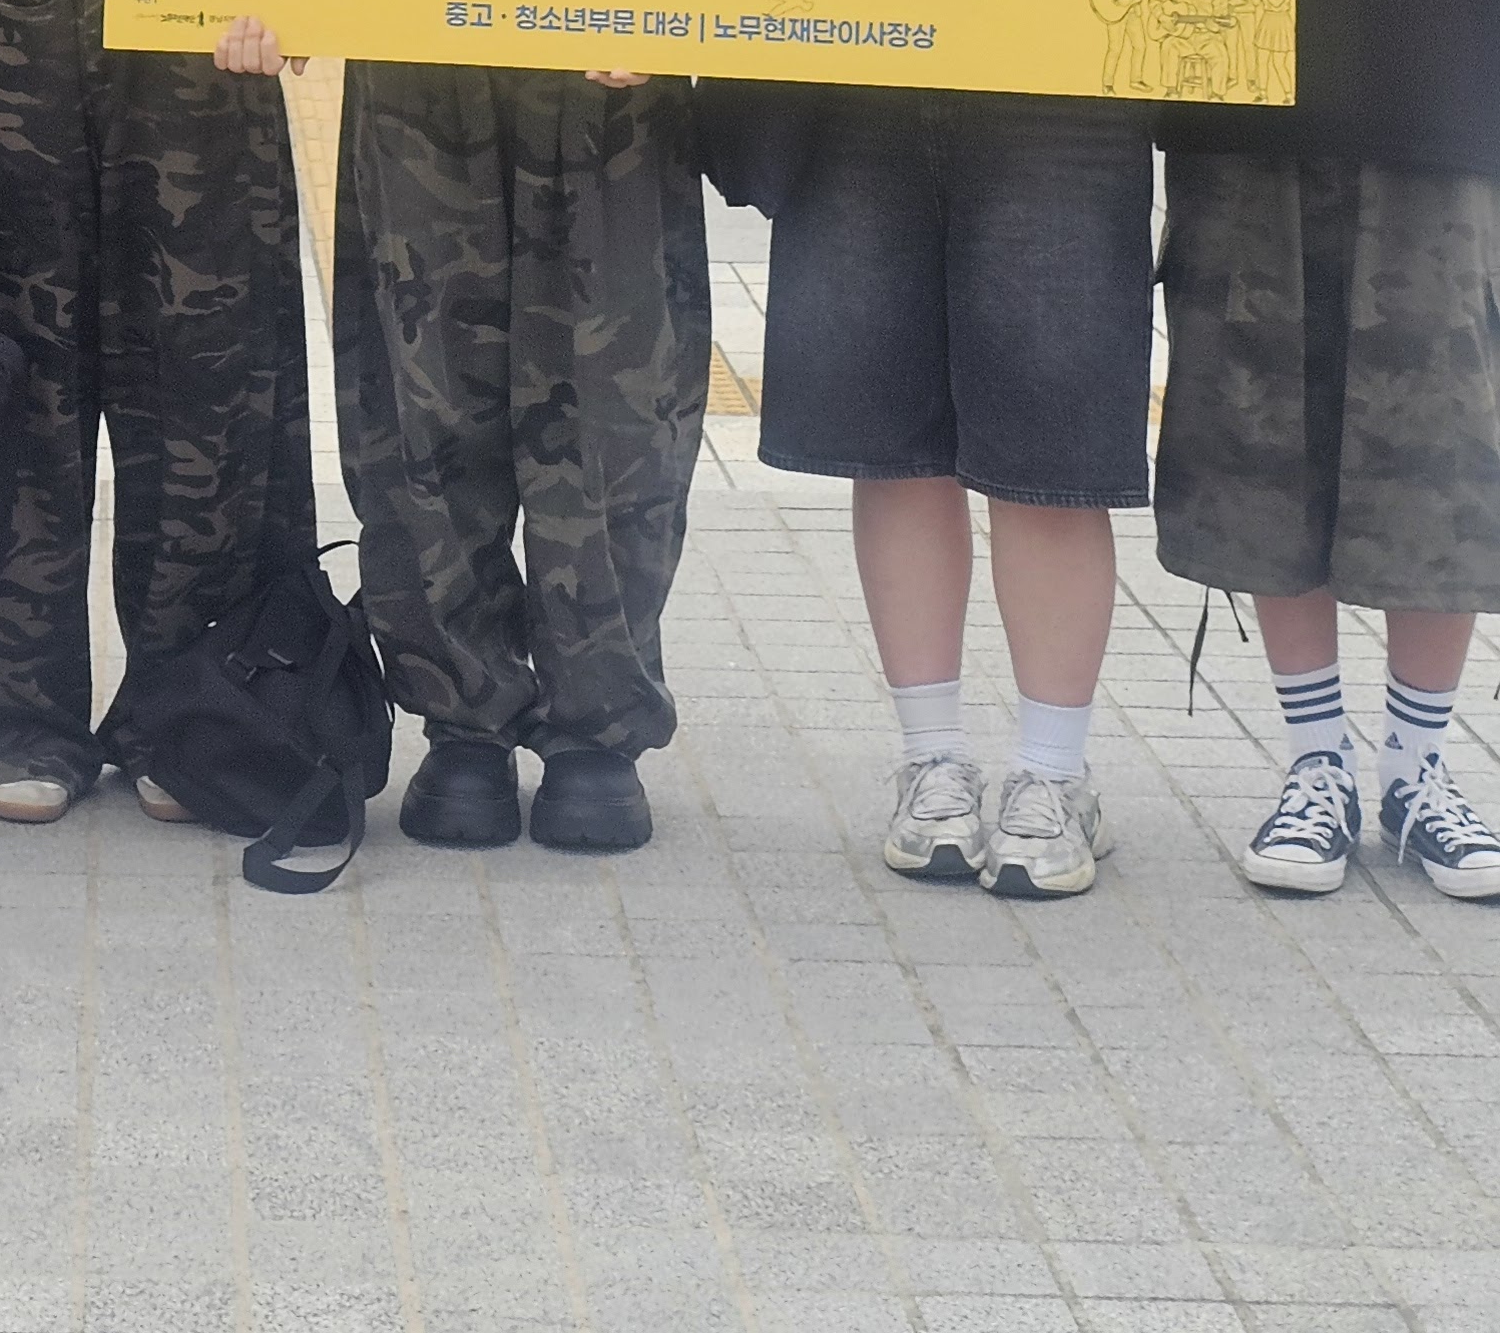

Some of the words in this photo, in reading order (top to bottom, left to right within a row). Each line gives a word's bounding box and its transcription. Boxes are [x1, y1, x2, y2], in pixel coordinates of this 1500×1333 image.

[445, 0, 494, 29] 중고
[514, 4, 637, 36] 청소년부문
[643, 10, 691, 38] 대상
[712, 14, 937, 50] 노무현재단이사장상
